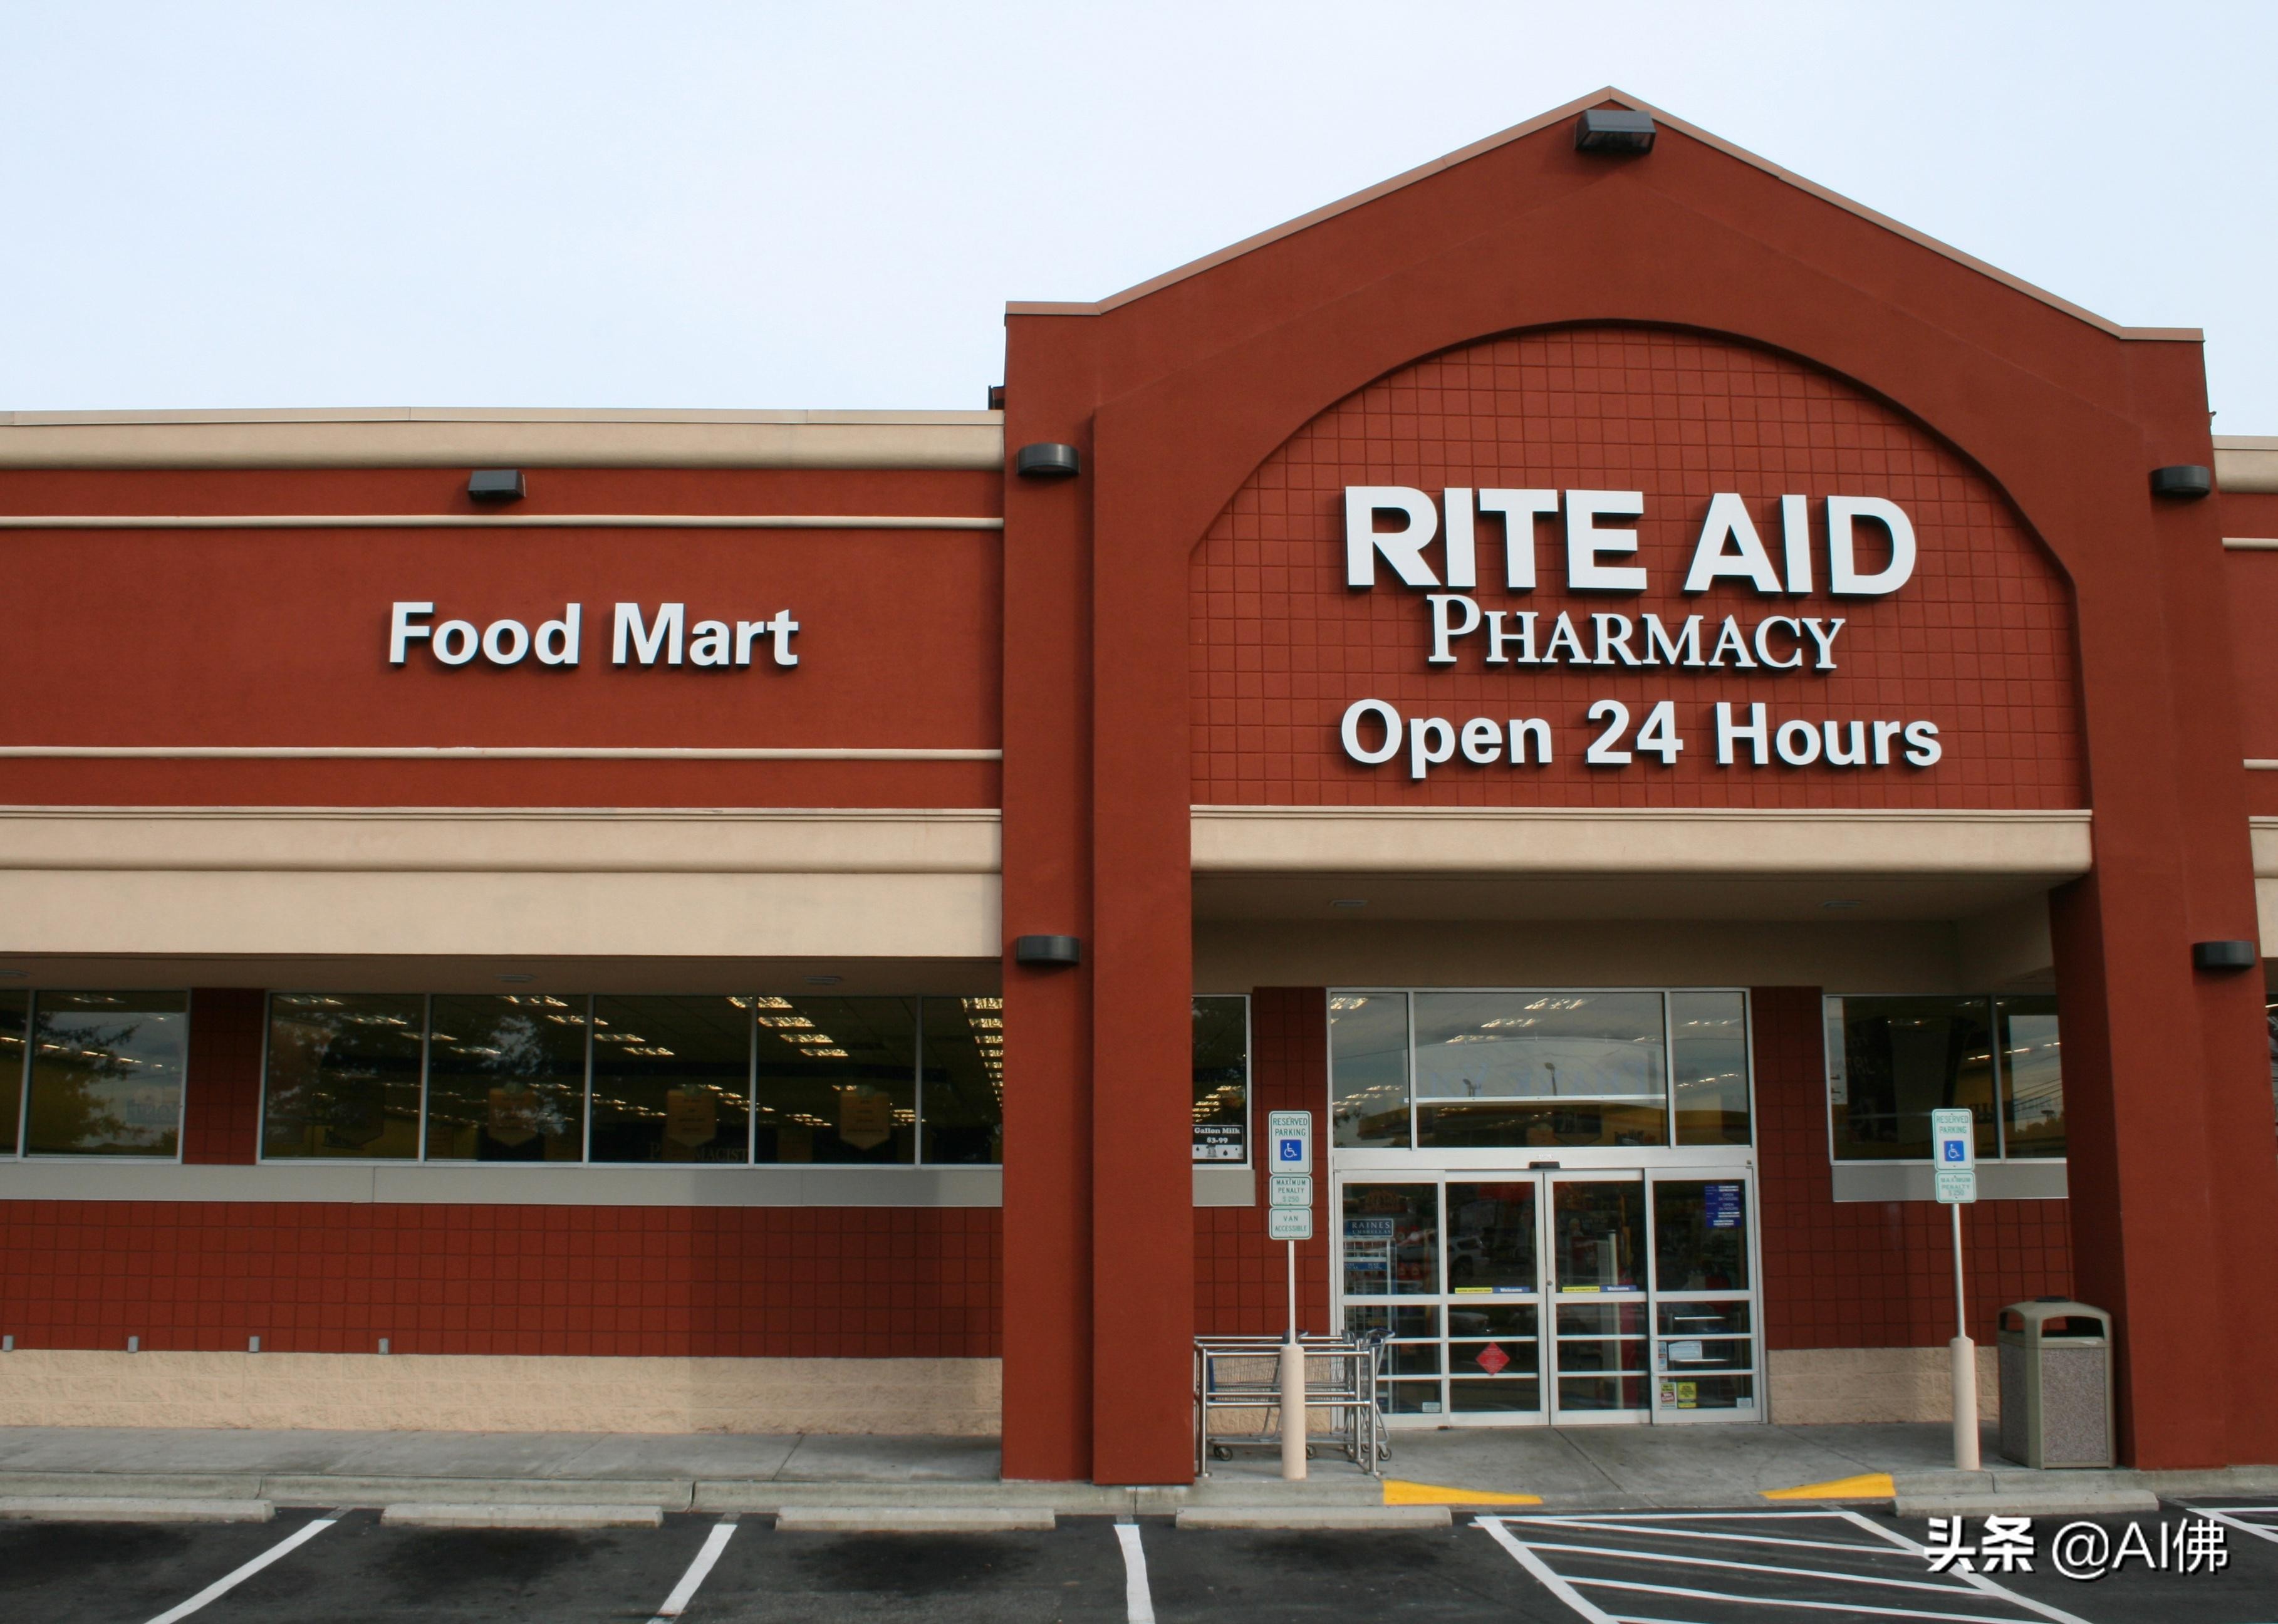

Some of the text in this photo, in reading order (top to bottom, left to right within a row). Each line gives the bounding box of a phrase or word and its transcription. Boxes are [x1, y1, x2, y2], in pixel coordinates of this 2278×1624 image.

[1344, 486, 1917, 595] RITE AID
[389, 601, 800, 667] Food Mart
[1427, 594, 1846, 670] PHARMACY
[1341, 699, 1942, 779] Open 24 Hours
[1273, 1118, 1308, 1126] RESERVED
[1936, 1115, 1969, 1123] RESERVED
